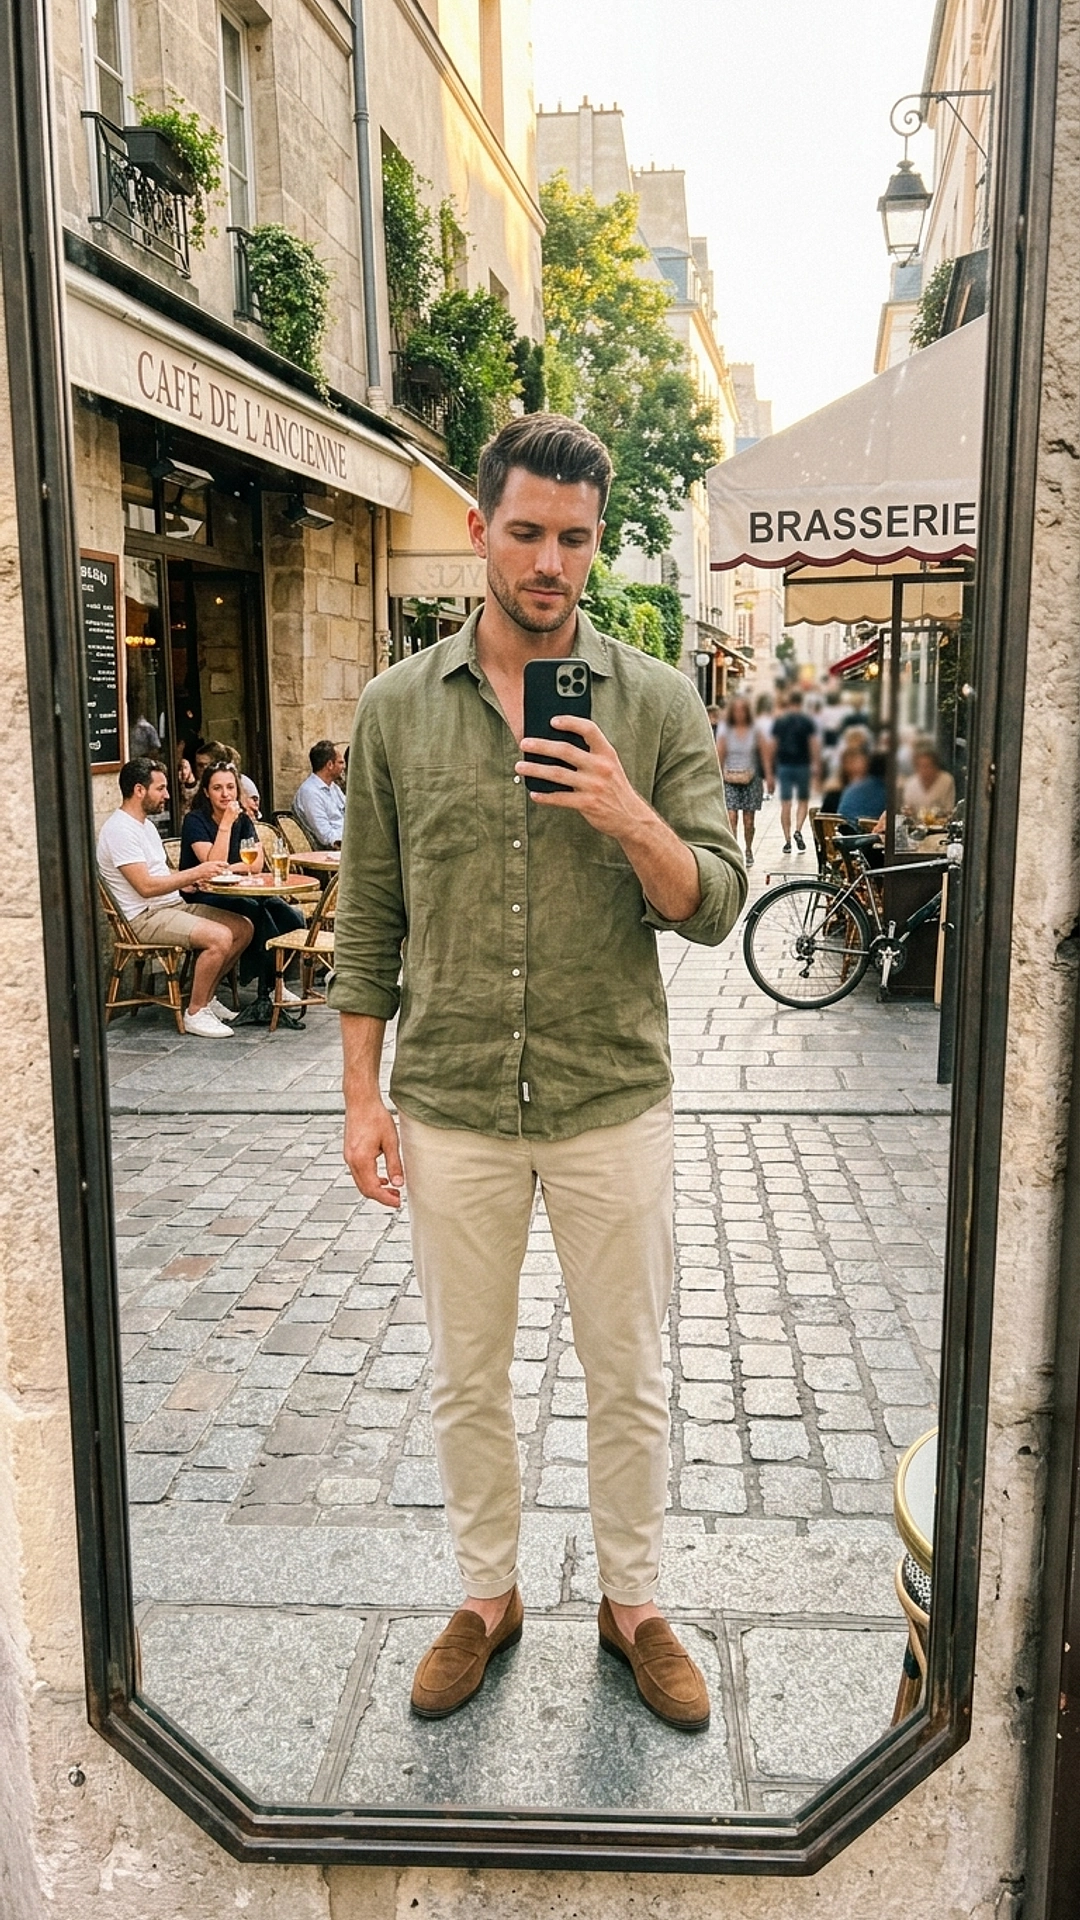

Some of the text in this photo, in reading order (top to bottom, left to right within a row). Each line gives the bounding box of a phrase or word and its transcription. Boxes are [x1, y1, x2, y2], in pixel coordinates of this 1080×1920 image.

[137, 350, 347, 480] CAFÉ DE L'ANCIENNE
[749, 502, 976, 543] BRASSERIE
